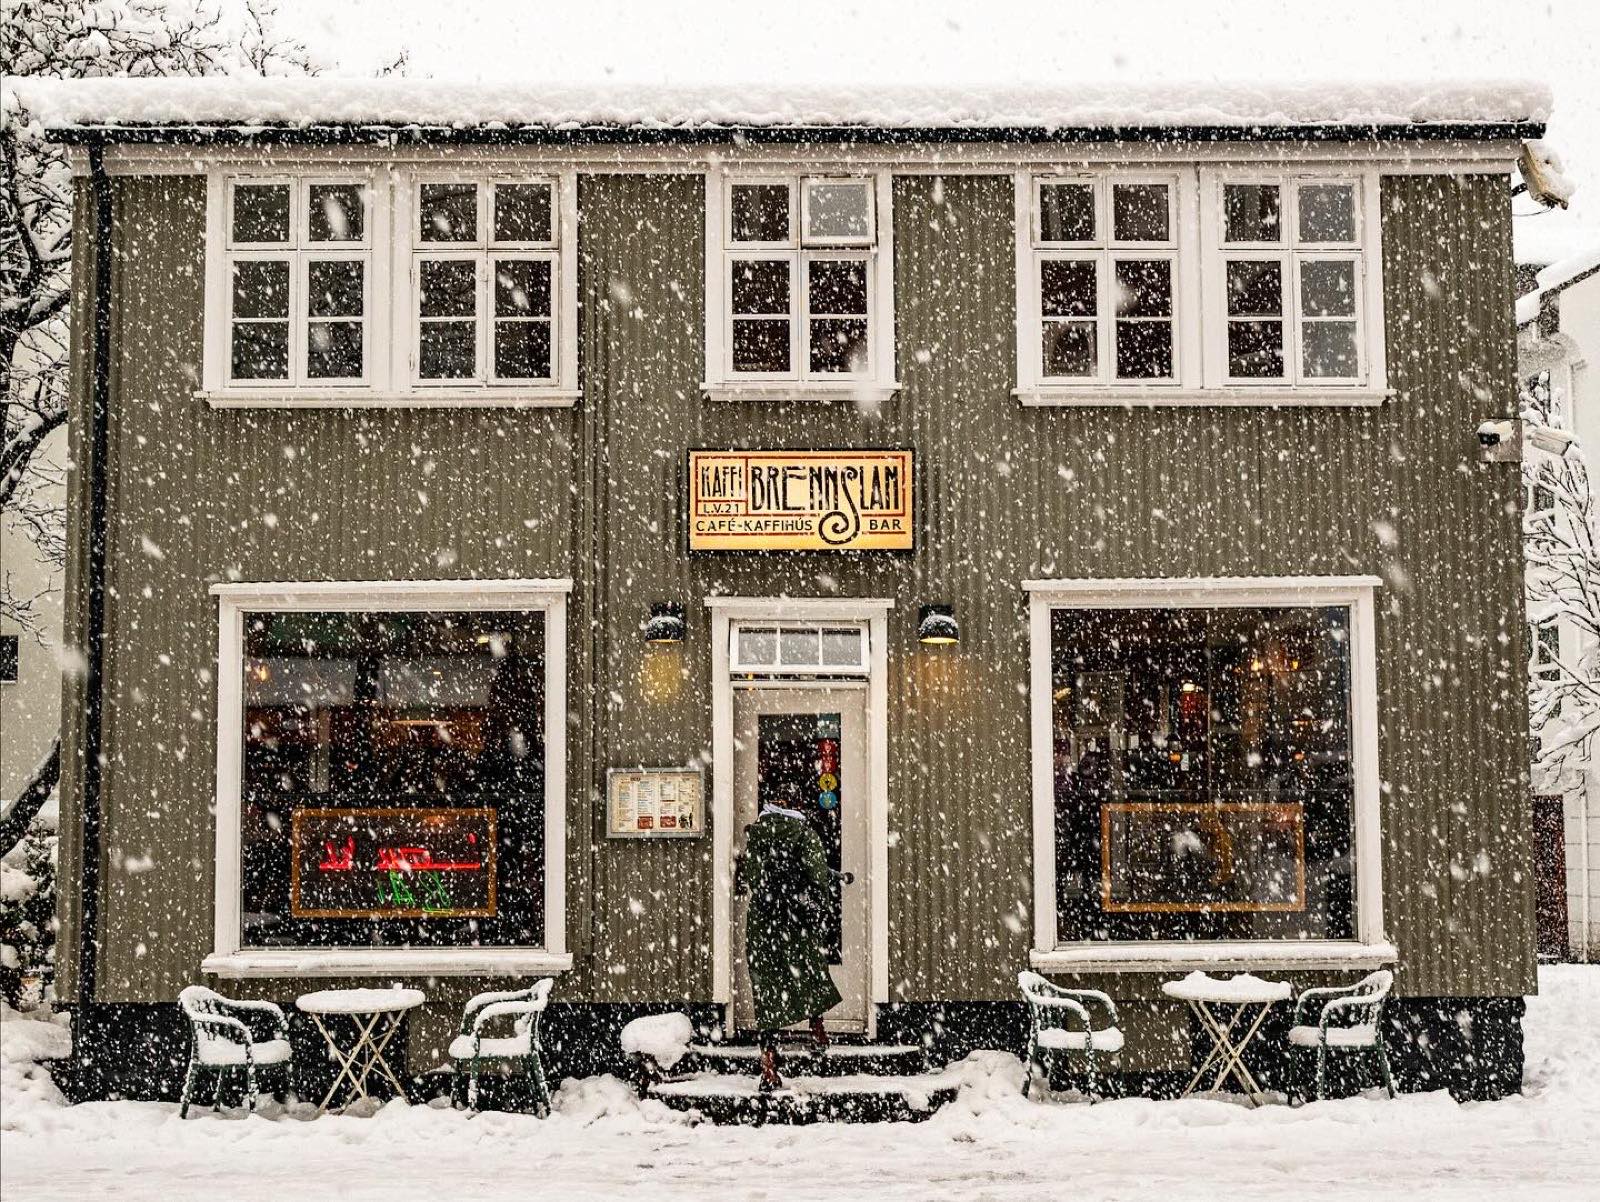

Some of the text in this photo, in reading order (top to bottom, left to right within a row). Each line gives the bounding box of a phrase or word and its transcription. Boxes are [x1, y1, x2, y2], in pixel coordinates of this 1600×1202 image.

[701, 465, 742, 497] KAFFI
[703, 503, 740, 514] L.V.21
[696, 517, 902, 532] CAFÉ-KAFFIHÚS BAR
